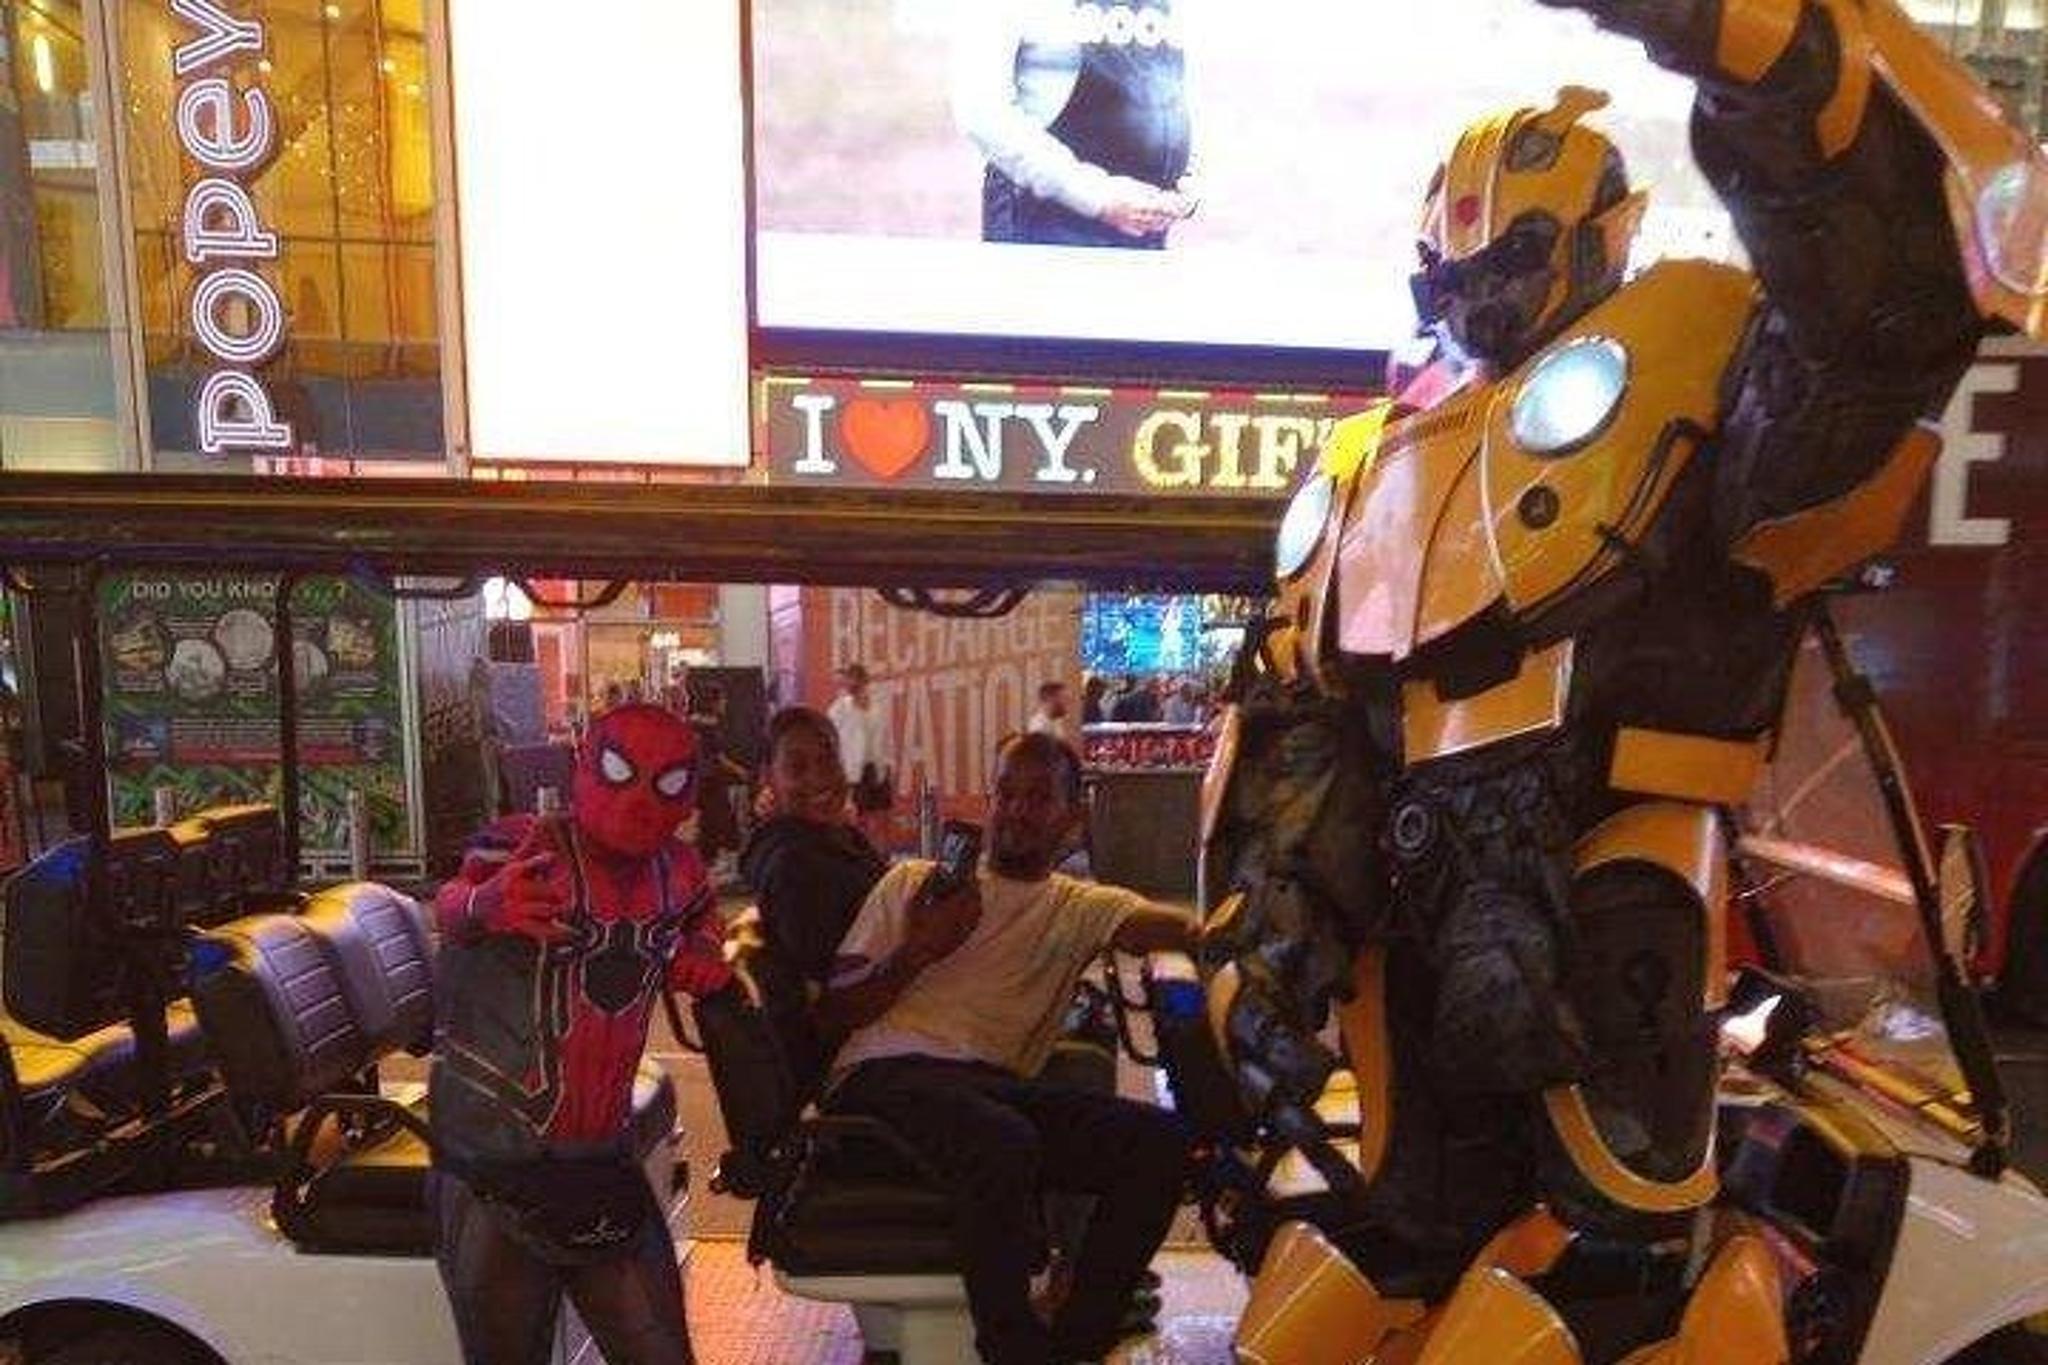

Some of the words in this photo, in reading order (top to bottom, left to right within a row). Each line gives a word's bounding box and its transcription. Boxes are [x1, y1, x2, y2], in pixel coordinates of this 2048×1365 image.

[792, 394, 837, 474] I
[1134, 410, 1334, 488] GIF
[1928, 363, 2022, 546] E
[177, 578, 224, 599] YOU
[226, 577, 279, 599] KNO
